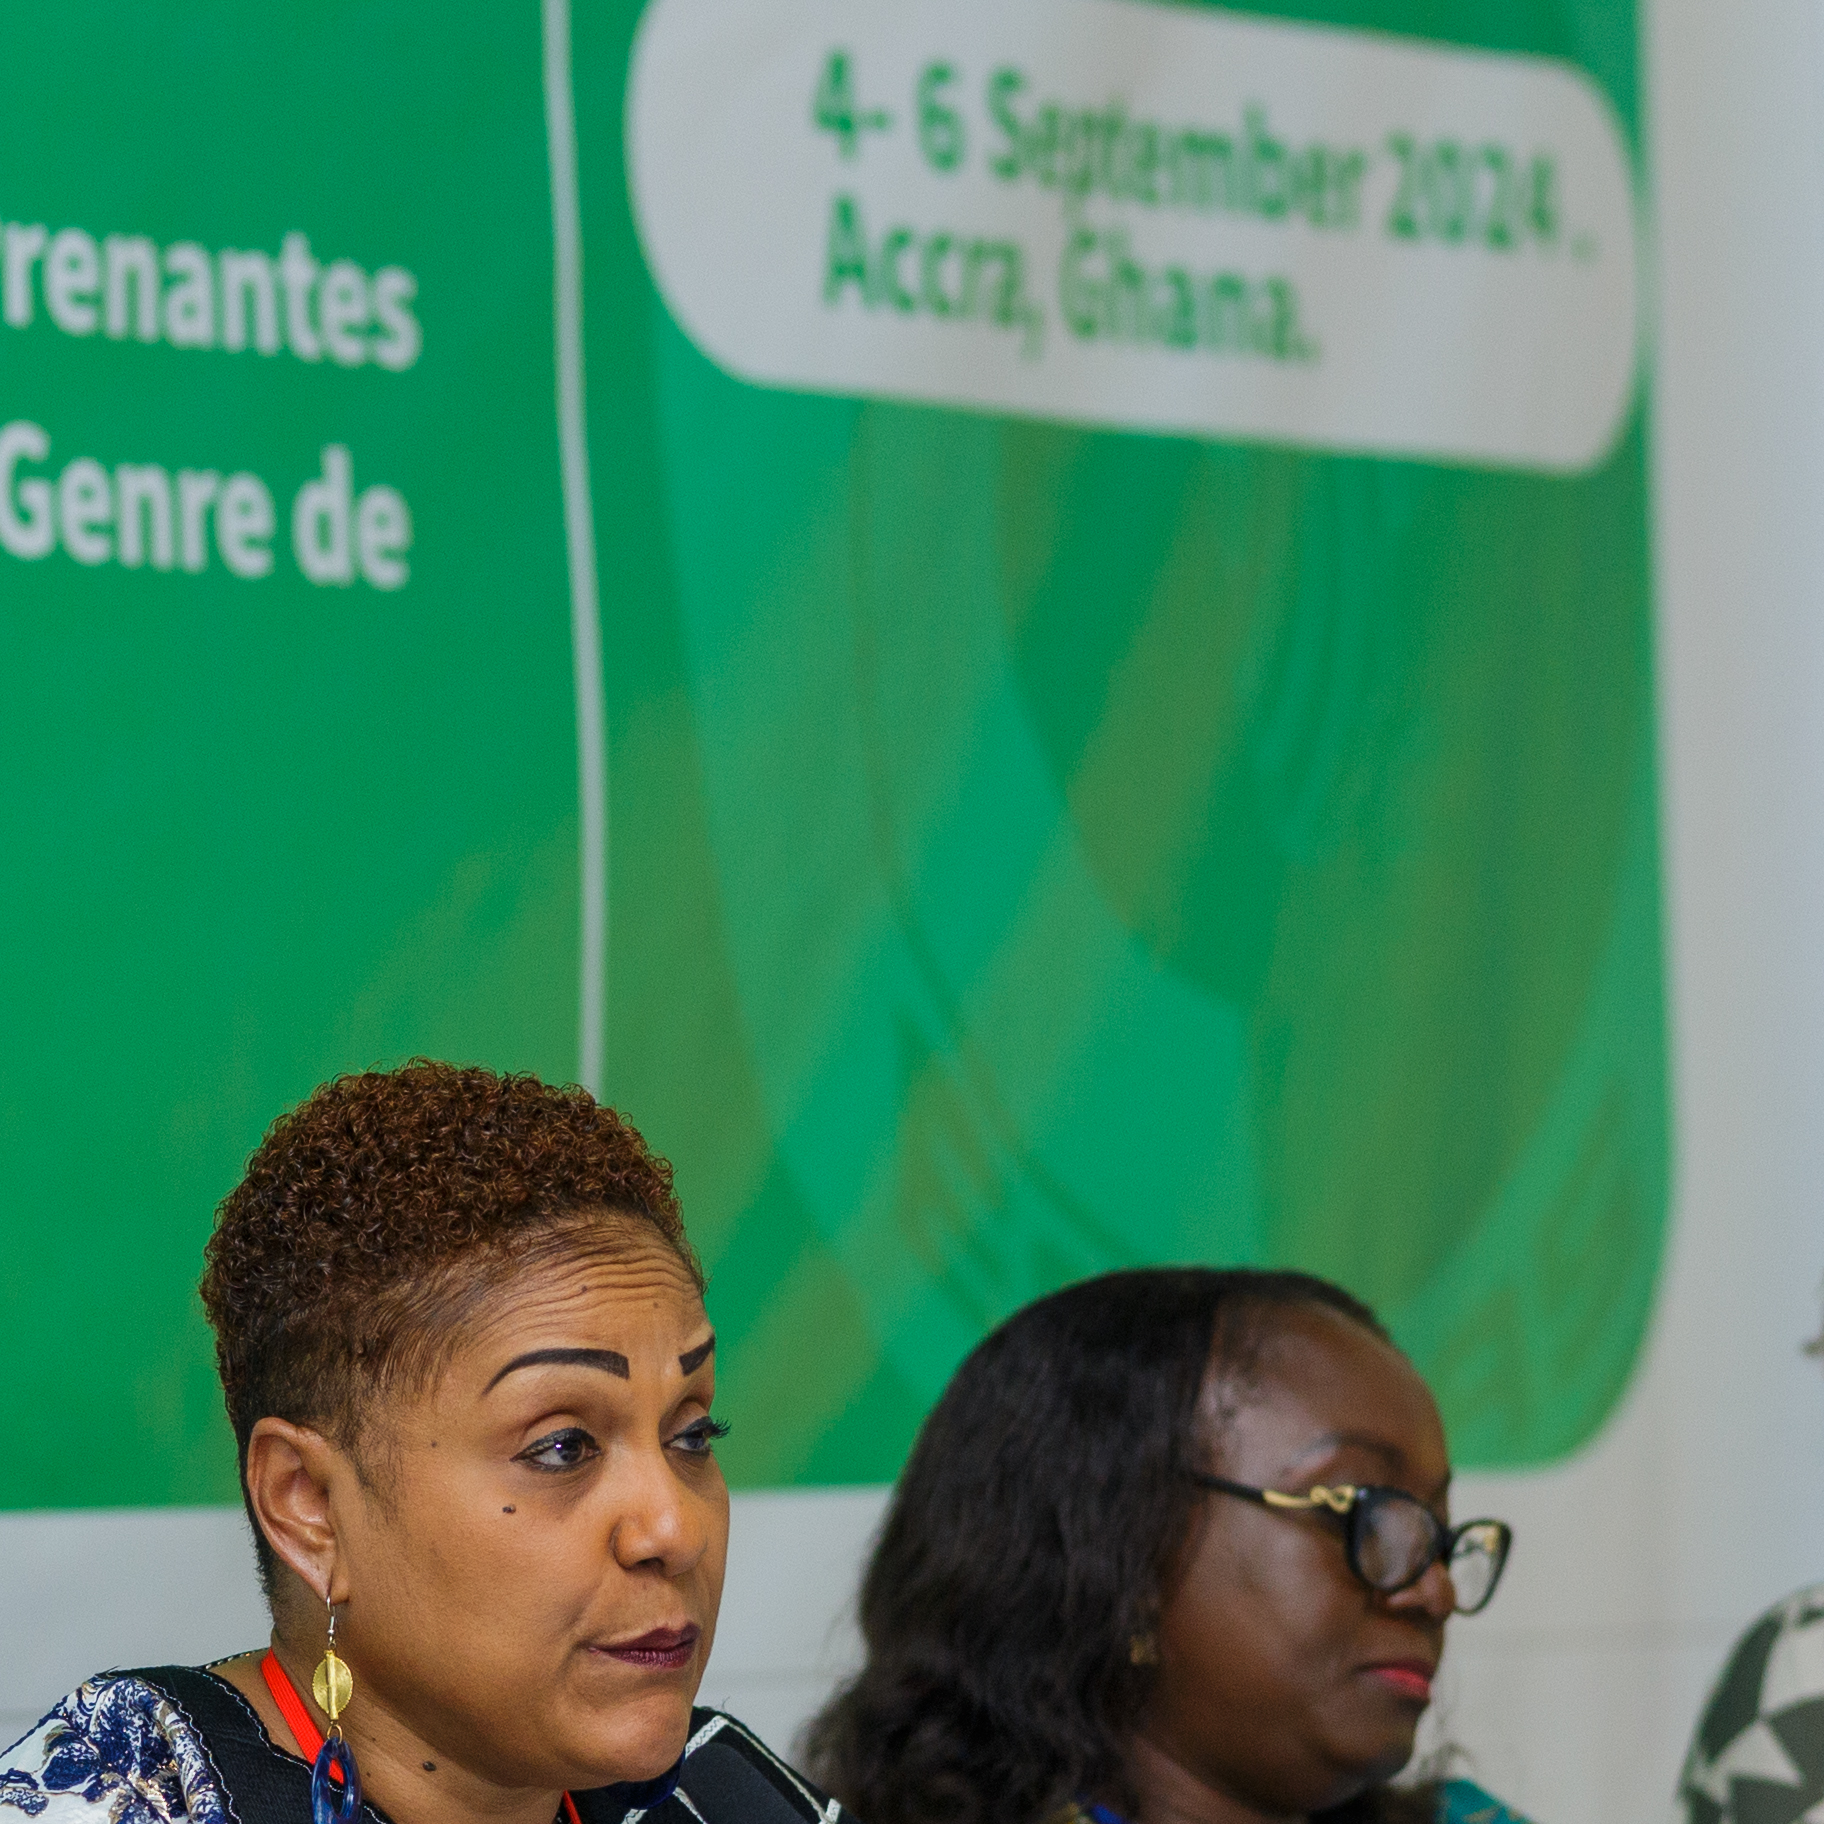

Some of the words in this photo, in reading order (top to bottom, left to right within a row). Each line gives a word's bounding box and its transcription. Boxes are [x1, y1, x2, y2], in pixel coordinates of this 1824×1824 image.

[916, 60, 965, 172] 6
[988, 66, 1368, 235] September
[824, 196, 1044, 364] Accra,
[1060, 226, 1320, 364] Ghana.
[292, 446, 411, 588] de
